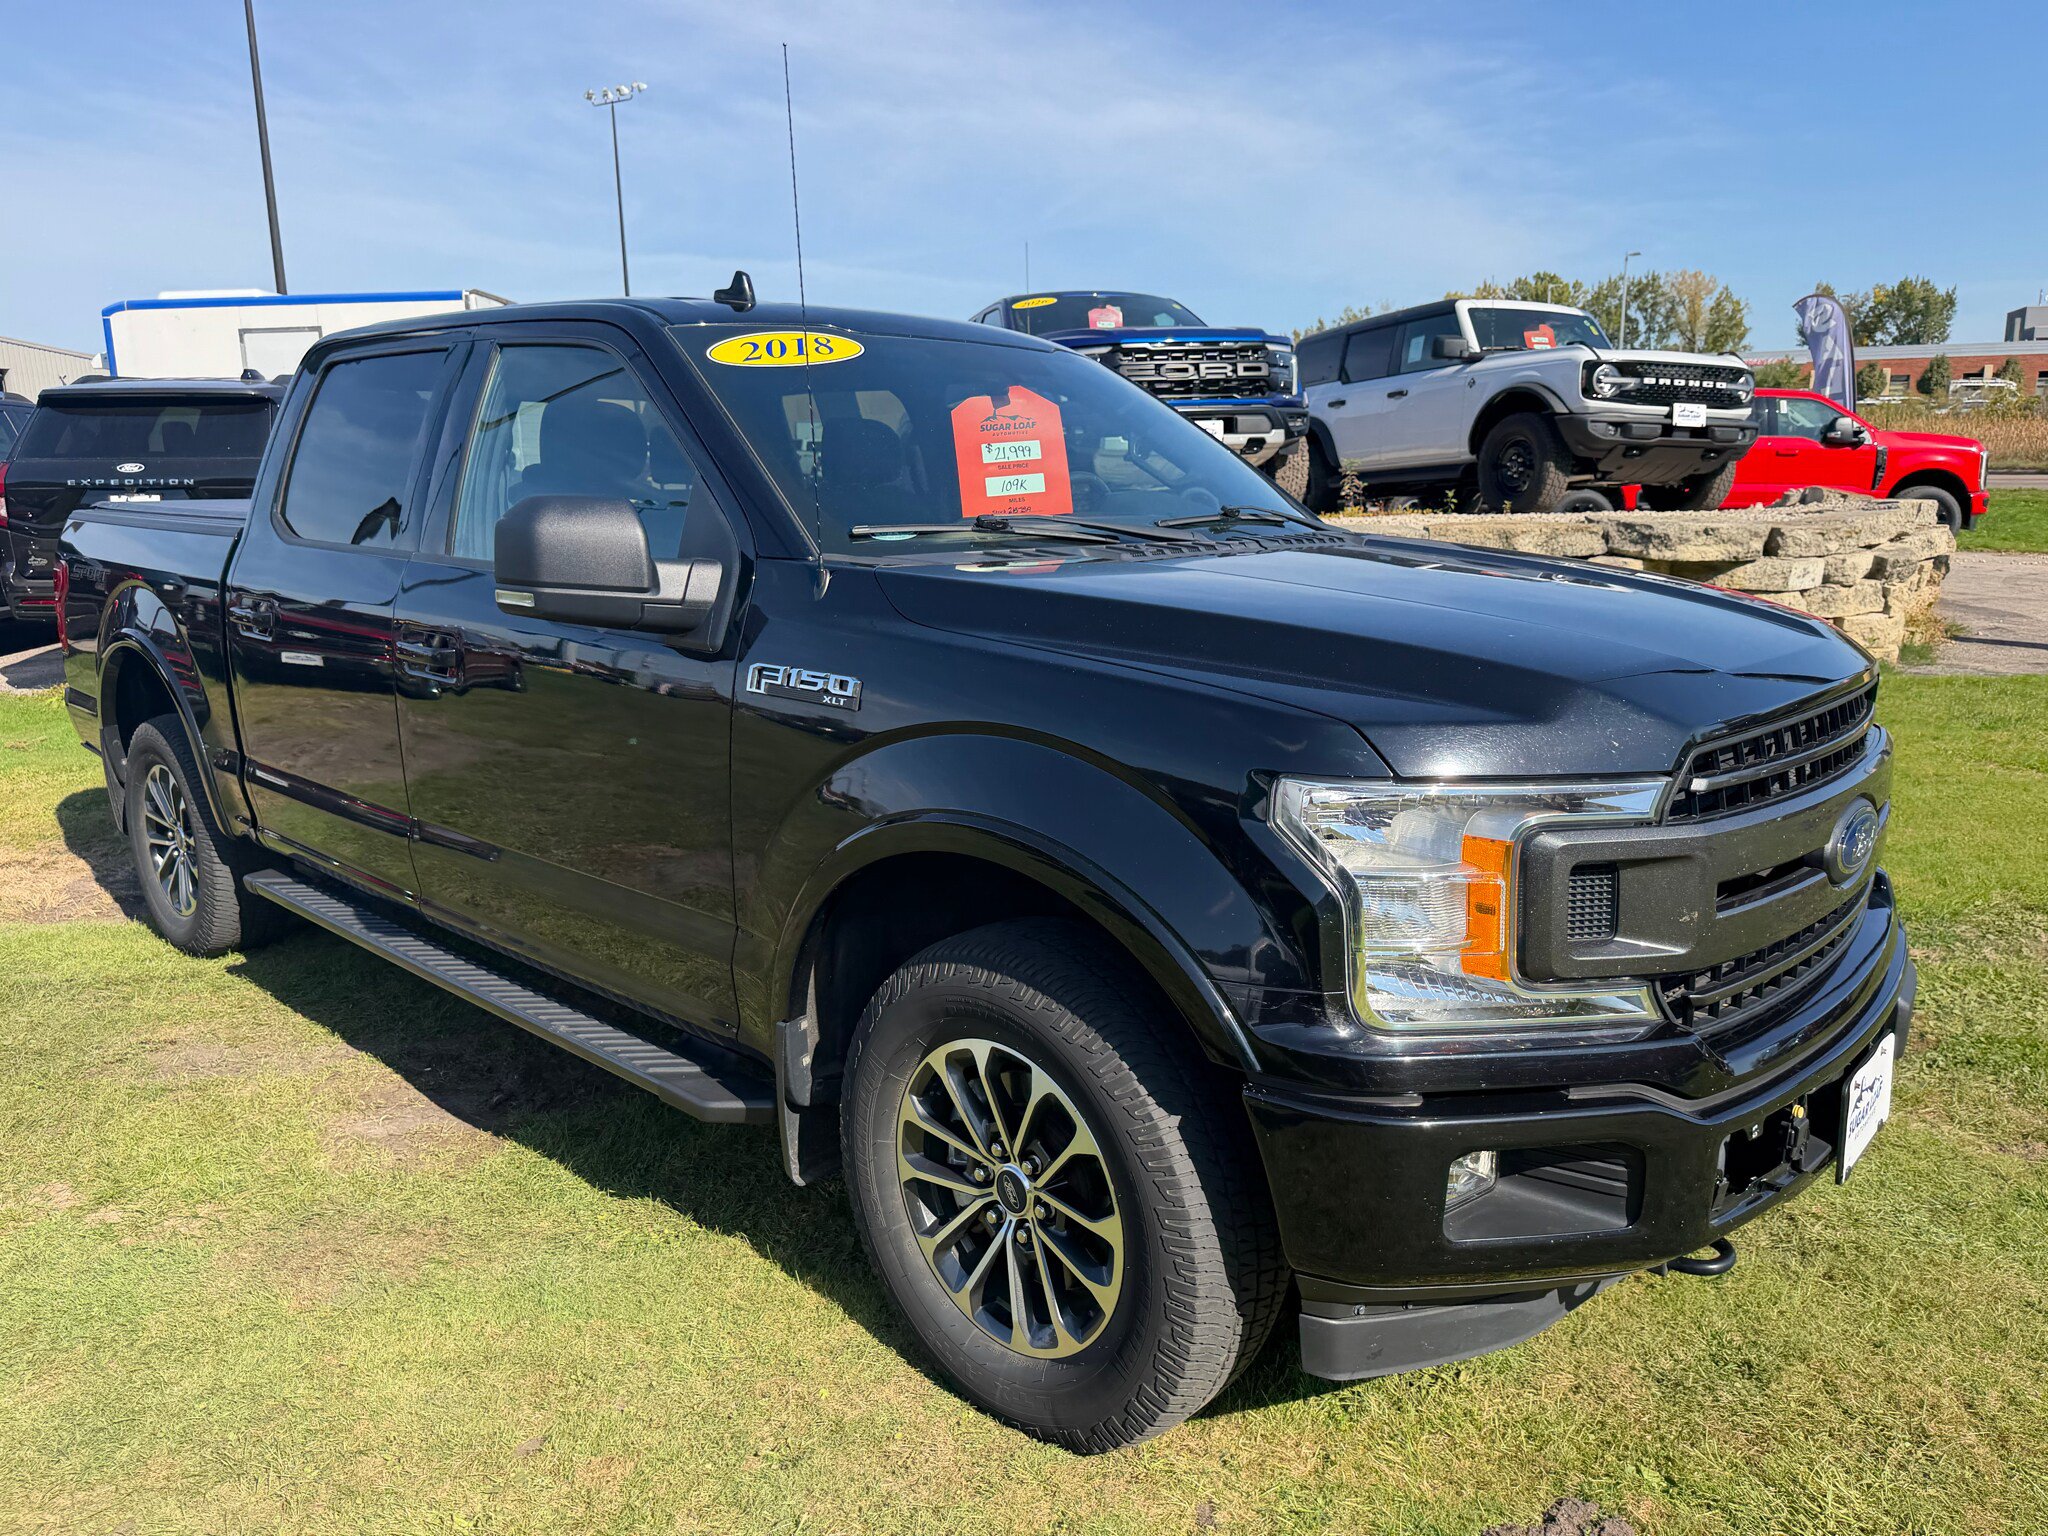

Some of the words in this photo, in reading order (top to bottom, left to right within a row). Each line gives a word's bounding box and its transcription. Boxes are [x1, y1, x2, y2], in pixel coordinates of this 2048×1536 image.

[740, 336, 834, 362] 2018
[1119, 361, 1270, 381] FORD
[1644, 378, 1726, 388] BRONCO
[980, 423, 1012, 433] SUGAR
[1013, 421, 1037, 430] LOAF
[67, 478, 195, 487] EXPEDITION
[1001, 478, 1027, 493] 109K
[72, 564, 111, 583] SPORT
[822, 695, 847, 706] XLT
